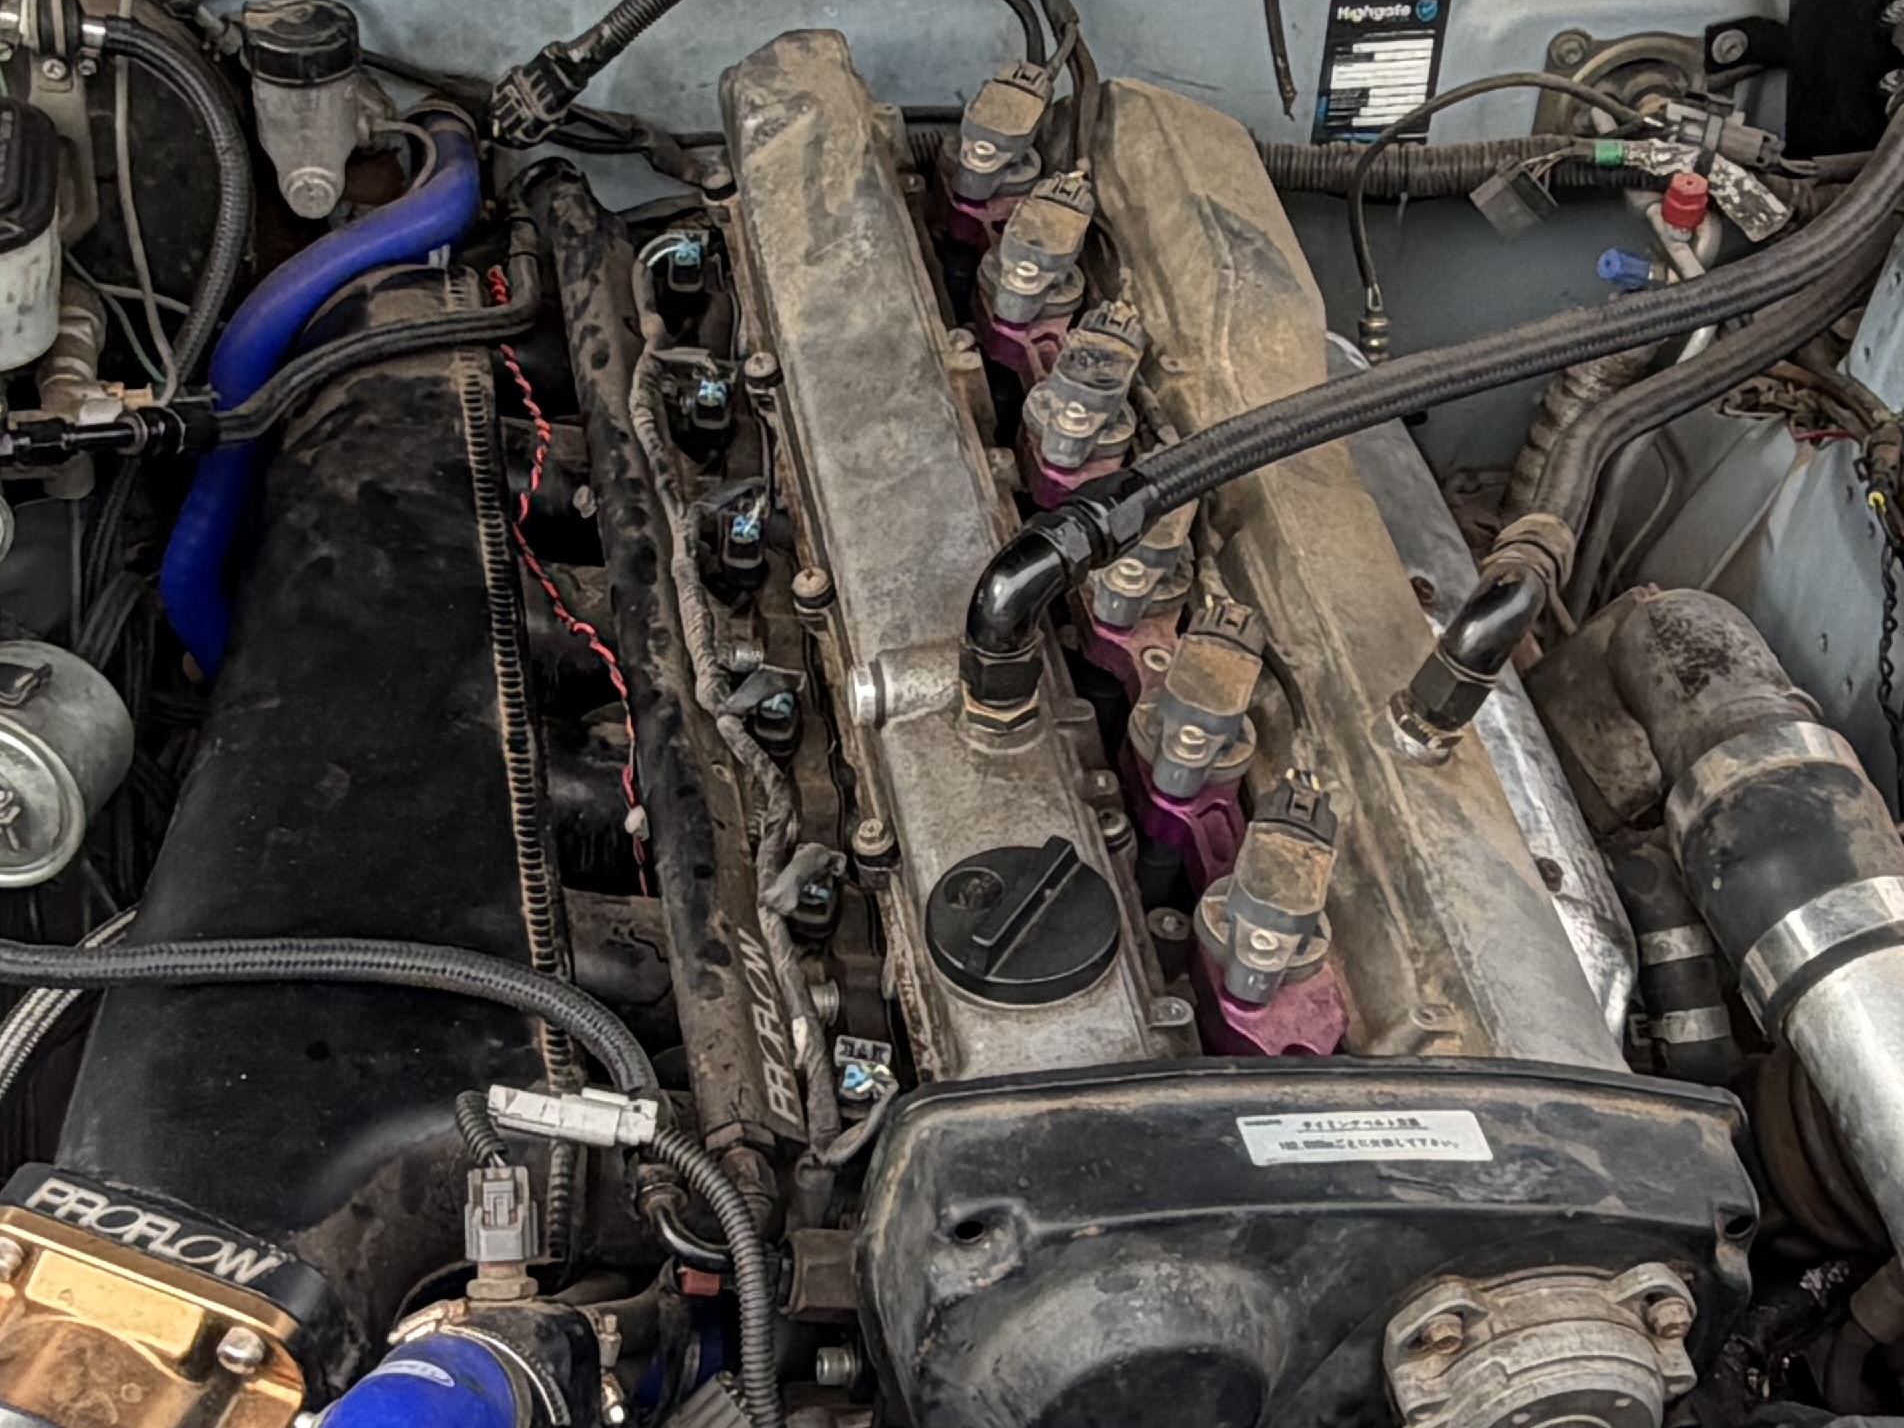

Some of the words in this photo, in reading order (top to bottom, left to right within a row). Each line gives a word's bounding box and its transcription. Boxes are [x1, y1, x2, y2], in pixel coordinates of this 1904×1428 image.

[1336, 3, 1412, 24] Highgate
[741, 927, 802, 1123] PROFLOW
[26, 1178, 282, 1285] PROFLOW
